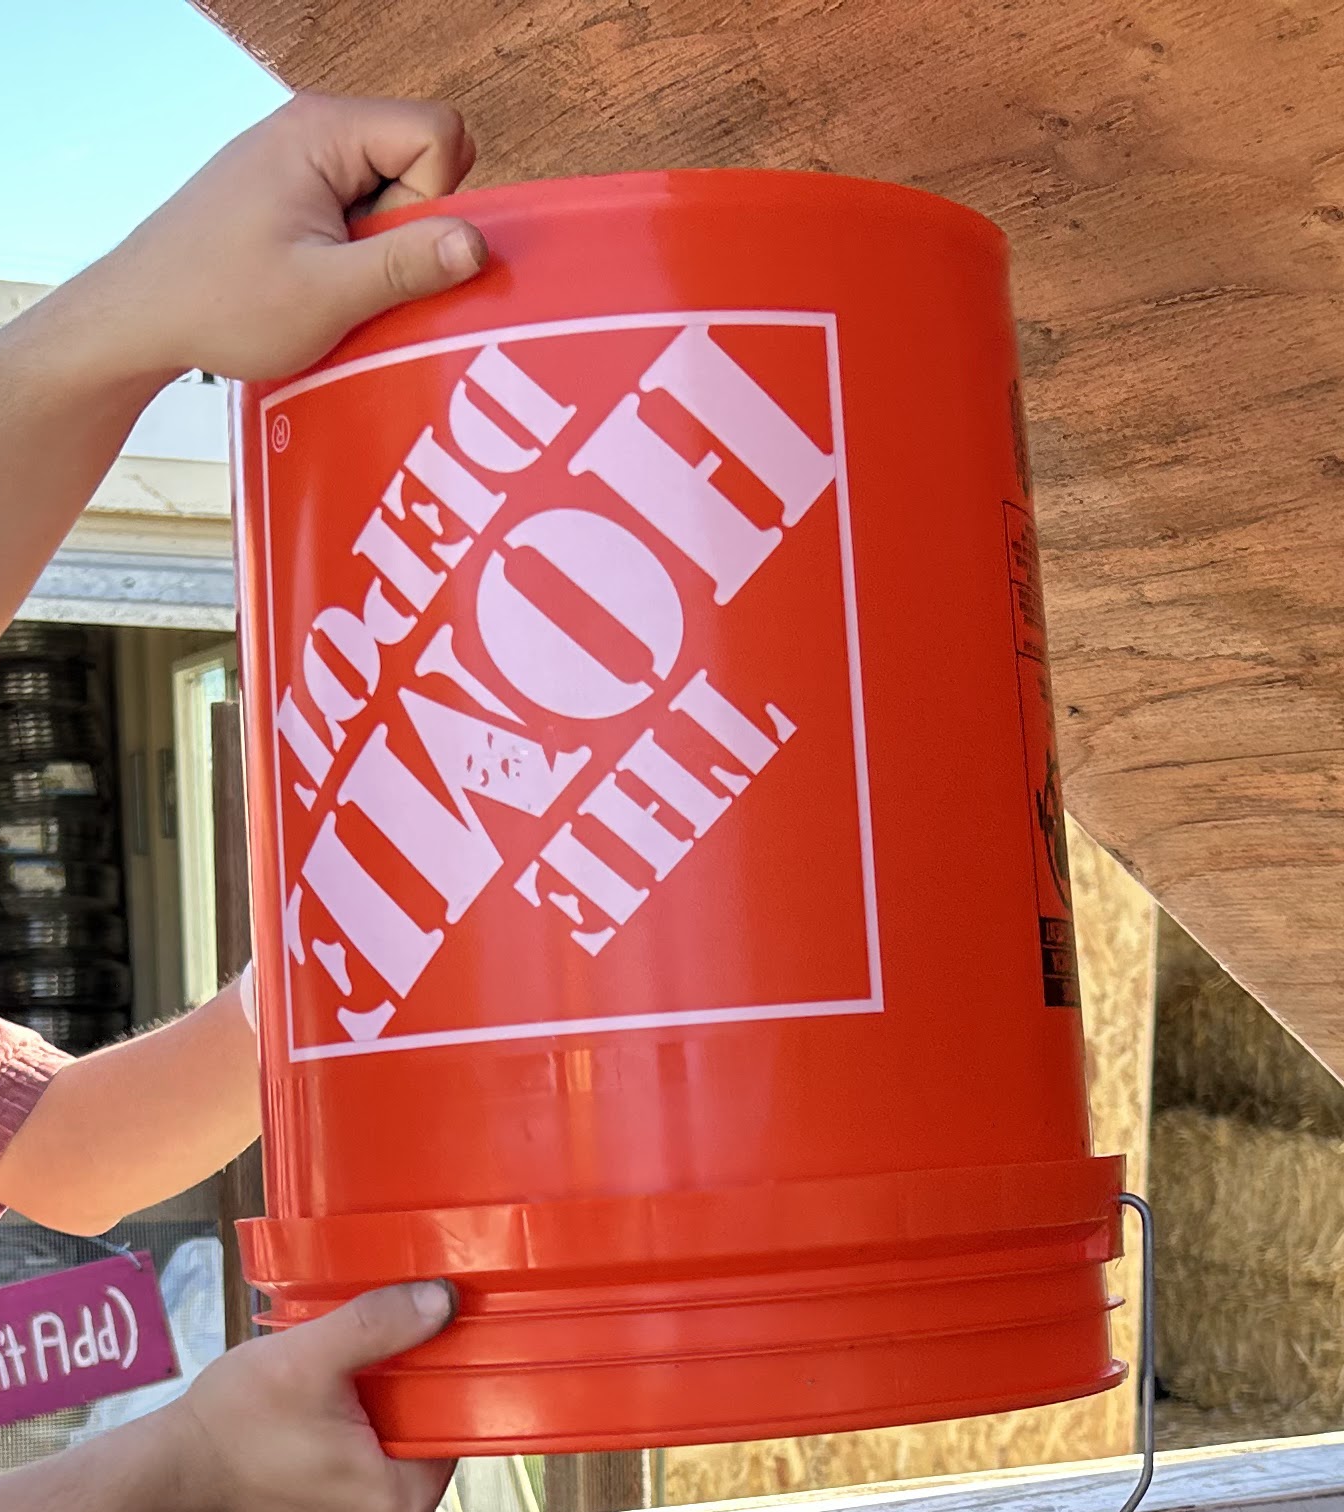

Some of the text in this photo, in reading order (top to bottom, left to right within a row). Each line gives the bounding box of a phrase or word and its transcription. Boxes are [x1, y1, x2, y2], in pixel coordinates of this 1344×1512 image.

[276, 344, 577, 811] DEPOT
[286, 324, 834, 1041] HOME
[514, 669, 797, 956] THE
[31, 1285, 138, 1383] Add)
